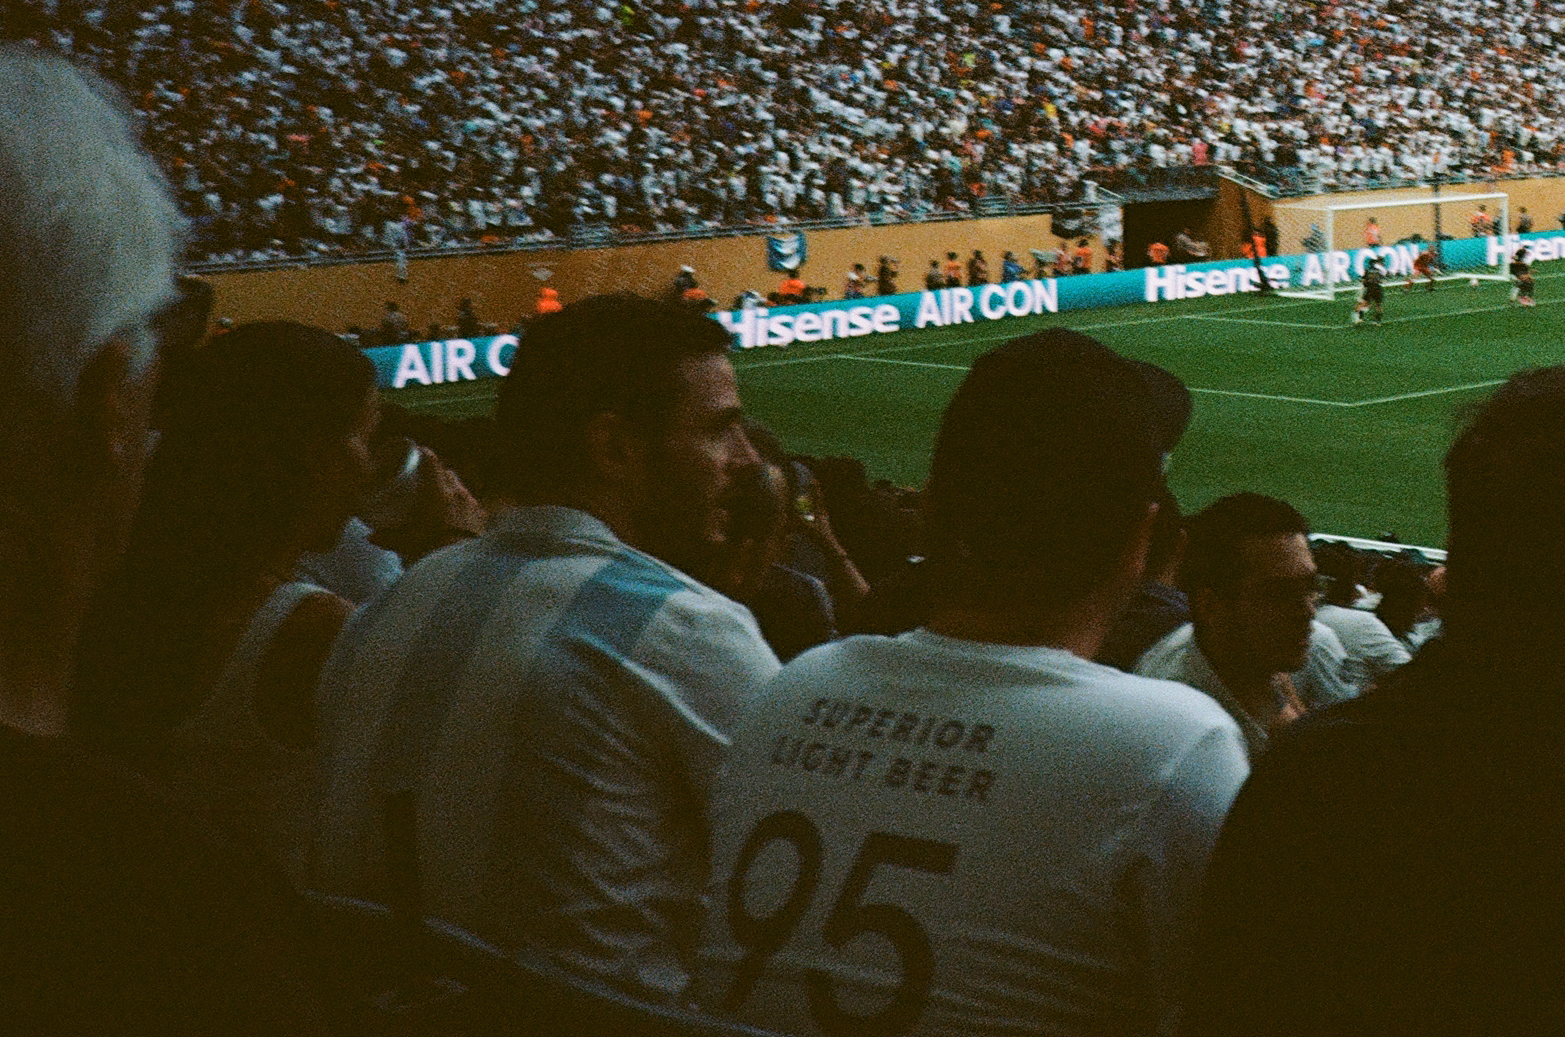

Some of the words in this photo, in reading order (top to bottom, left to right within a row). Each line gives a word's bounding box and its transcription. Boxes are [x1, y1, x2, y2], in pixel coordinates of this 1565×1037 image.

[915, 288, 975, 329] AIR
[979, 278, 1059, 321] CON
[393, 338, 477, 389] AIR
[802, 698, 996, 754] SUPERIOR
[771, 734, 876, 778] LIGHT
[884, 758, 996, 803] BEER
[726, 810, 960, 1037] 95
